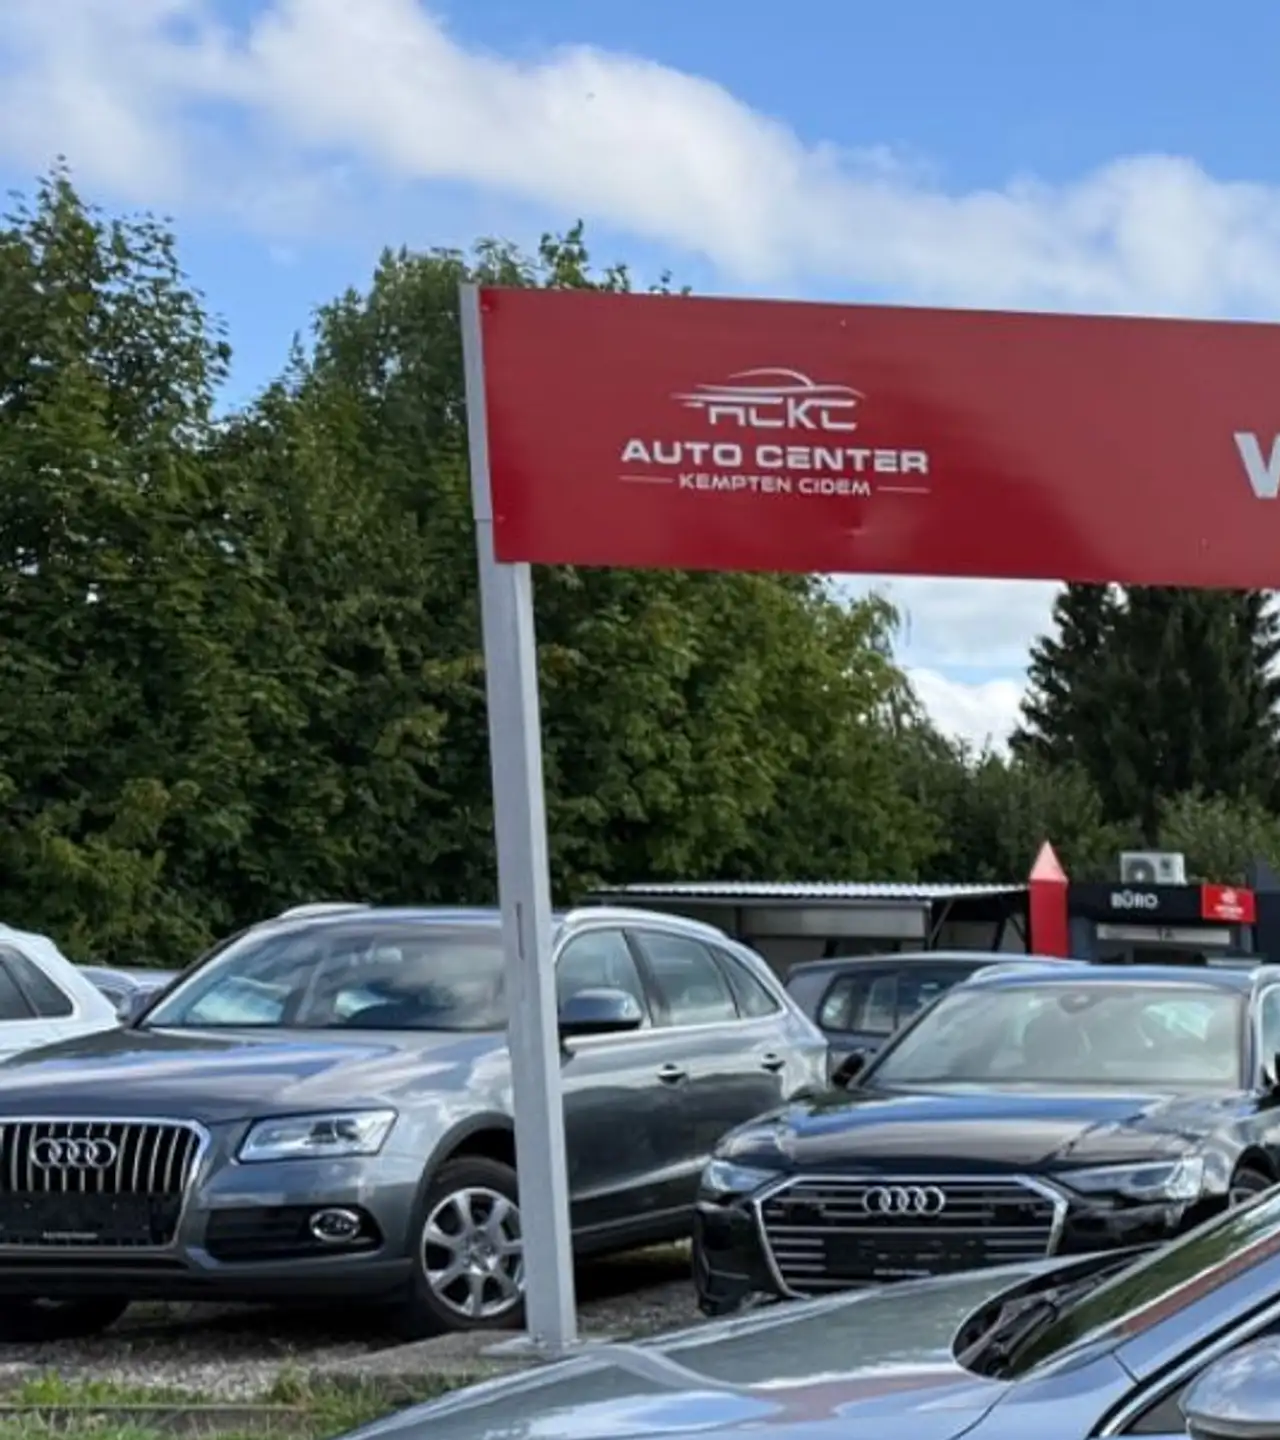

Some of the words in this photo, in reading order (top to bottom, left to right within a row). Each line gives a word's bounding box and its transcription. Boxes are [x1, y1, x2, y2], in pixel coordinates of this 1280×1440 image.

[621, 438, 743, 466] AUTO
[755, 445, 929, 474] CENTER
[679, 473, 792, 493] KEMPTEN
[798, 477, 871, 496] CIDEM
[1110, 889, 1158, 910] BÜRO
